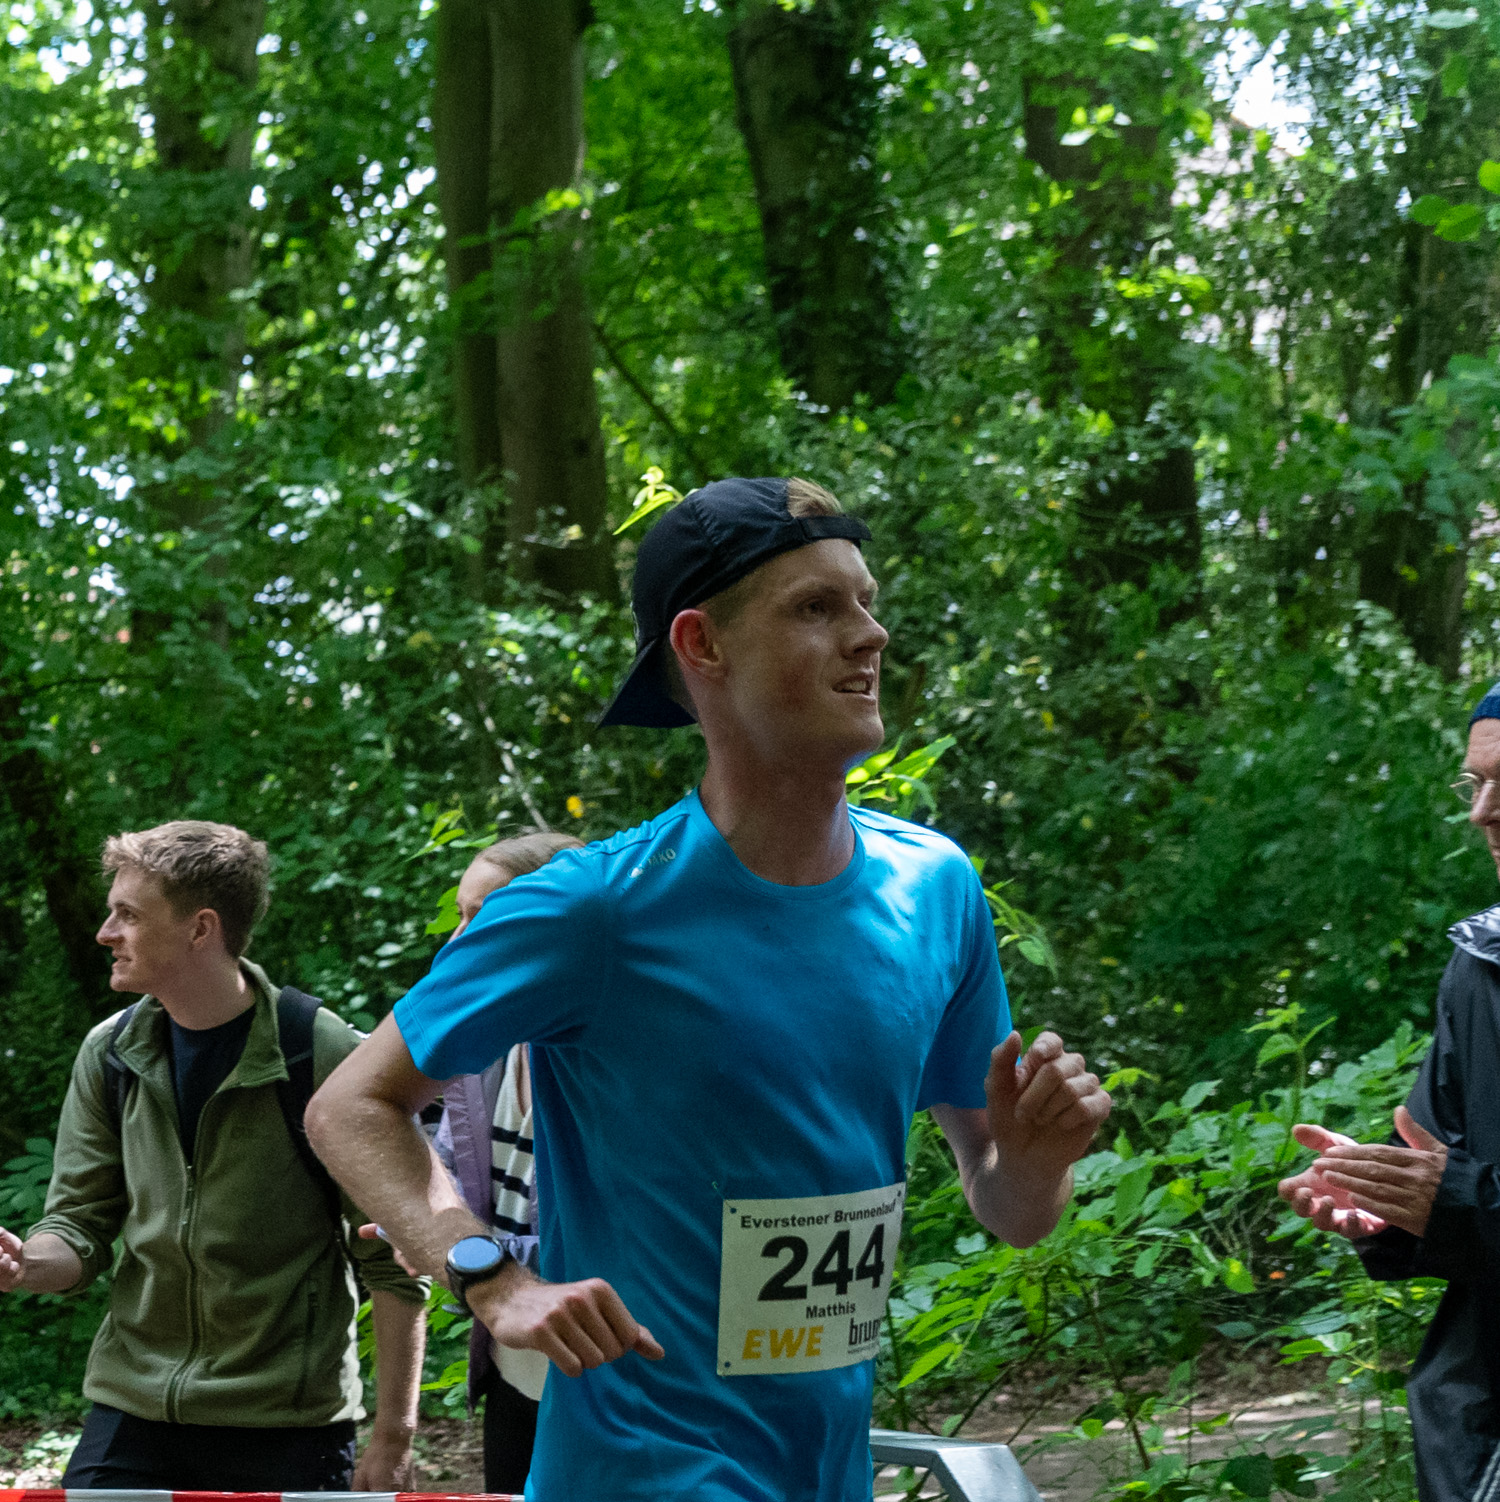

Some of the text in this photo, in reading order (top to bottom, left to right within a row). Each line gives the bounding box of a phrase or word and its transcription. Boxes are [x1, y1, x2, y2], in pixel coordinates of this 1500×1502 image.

[740, 1199, 896, 1230] Everstener Brunnenlauf
[757, 1223, 885, 1302] 244
[805, 1302, 856, 1319] Matthis
[742, 1325, 824, 1360] EWE
[848, 1318, 880, 1346] brun
